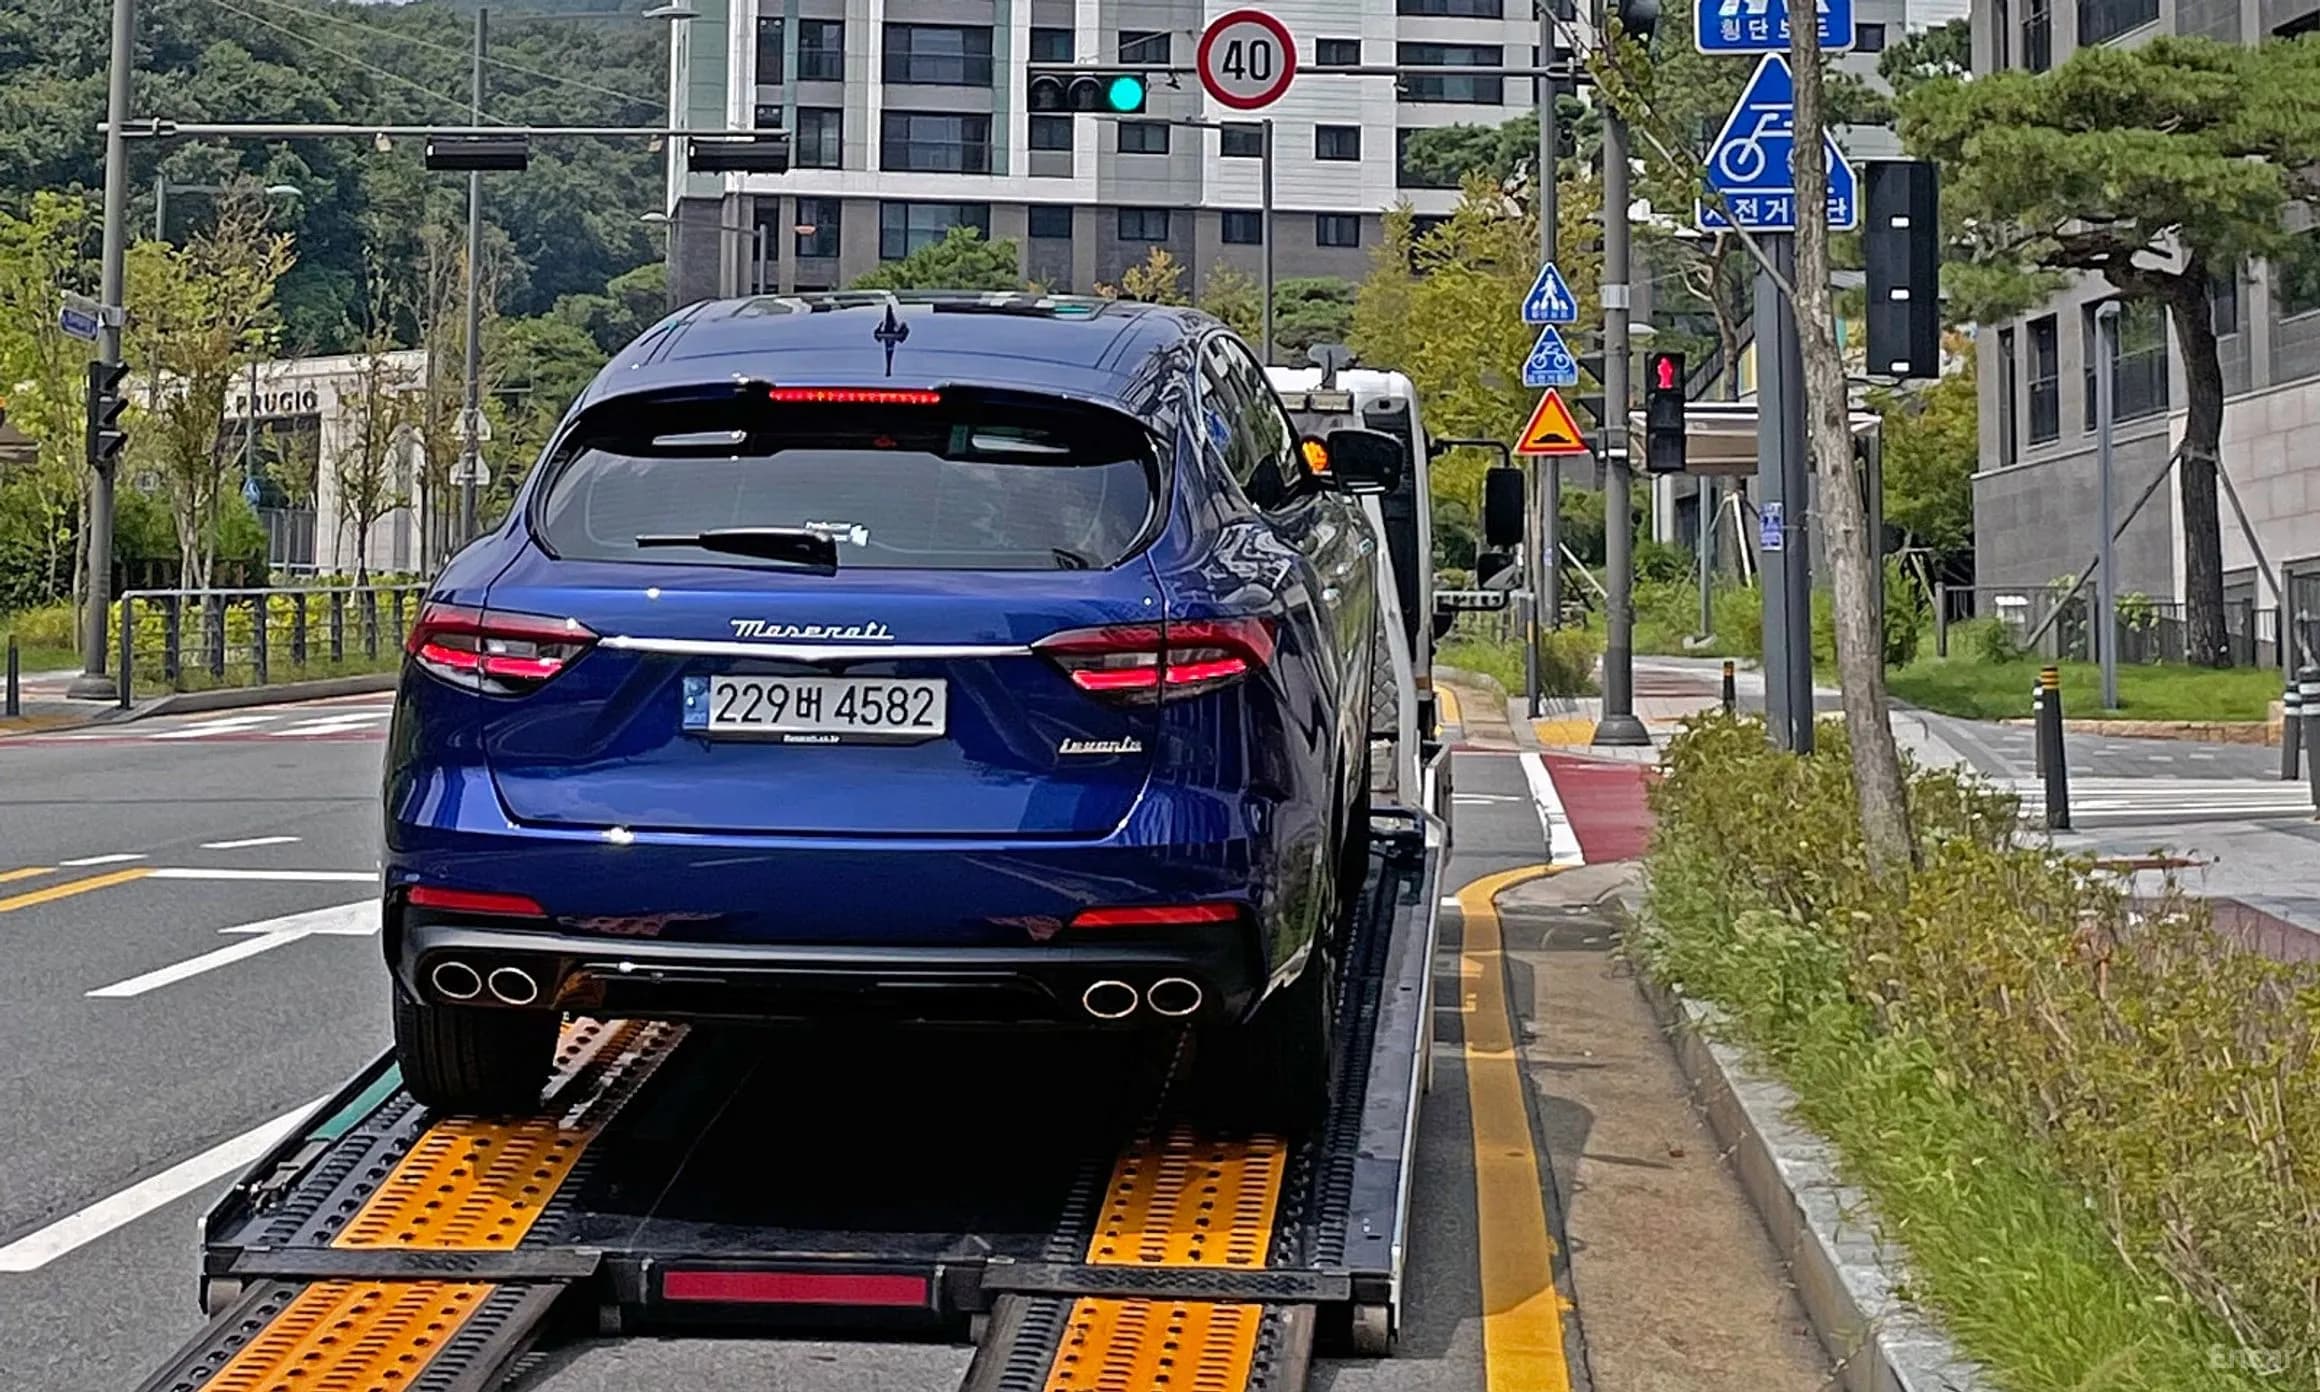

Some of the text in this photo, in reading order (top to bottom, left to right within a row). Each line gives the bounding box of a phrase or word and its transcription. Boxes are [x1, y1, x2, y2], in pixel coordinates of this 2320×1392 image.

[1222, 40, 1271, 80] 40
[236, 390, 318, 415] PRUGIO
[731, 619, 895, 640] Maserati
[715, 683, 823, 723] 229버
[833, 685, 935, 726] 4582
[1059, 735, 1142, 753] Levante
